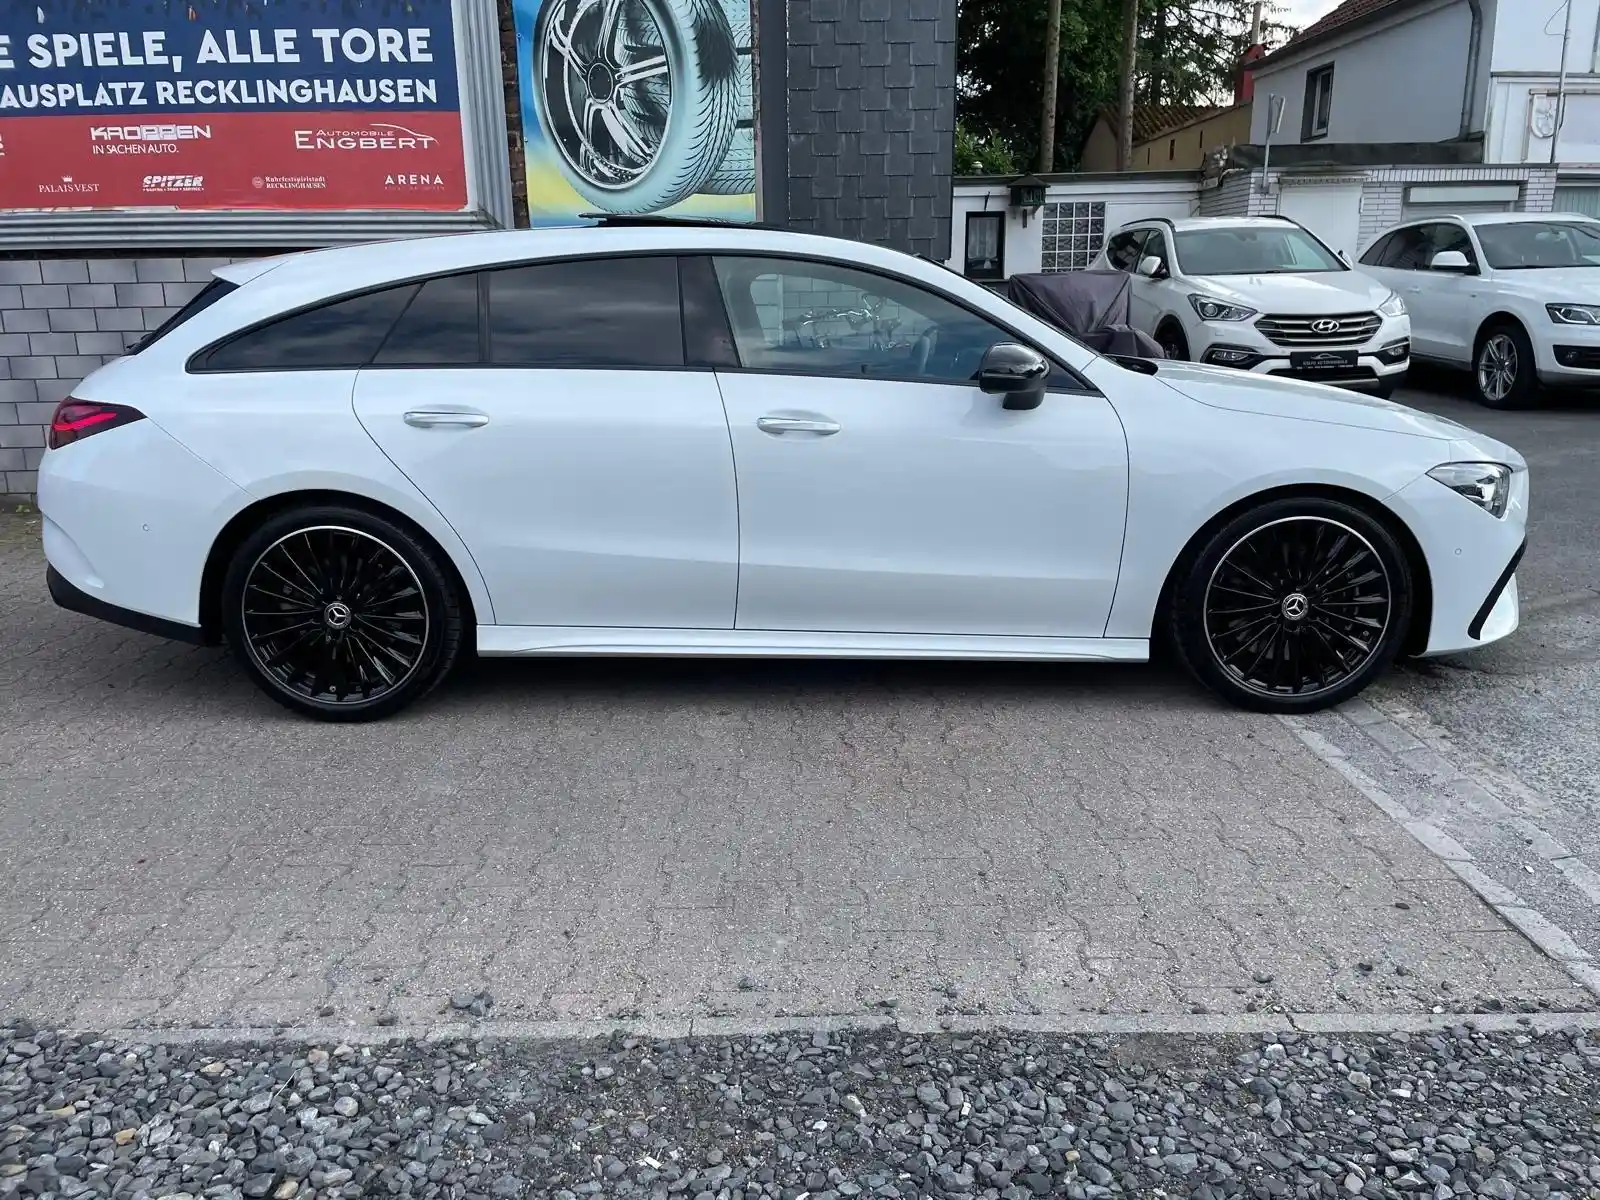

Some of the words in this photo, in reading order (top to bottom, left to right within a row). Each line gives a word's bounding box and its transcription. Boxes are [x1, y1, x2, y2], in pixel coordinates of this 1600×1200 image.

[27, 31, 182, 72] SPIELE,
[196, 28, 300, 64] ALLE
[312, 28, 433, 63] TORE
[156, 79, 437, 105] RECKLINGHAUSEN
[294, 130, 434, 150] ENGBERT
[92, 145, 104, 154] IN
[106, 144, 146, 154] SACHEN
[142, 175, 204, 187] SPITZER
[385, 174, 444, 185] ARENA
